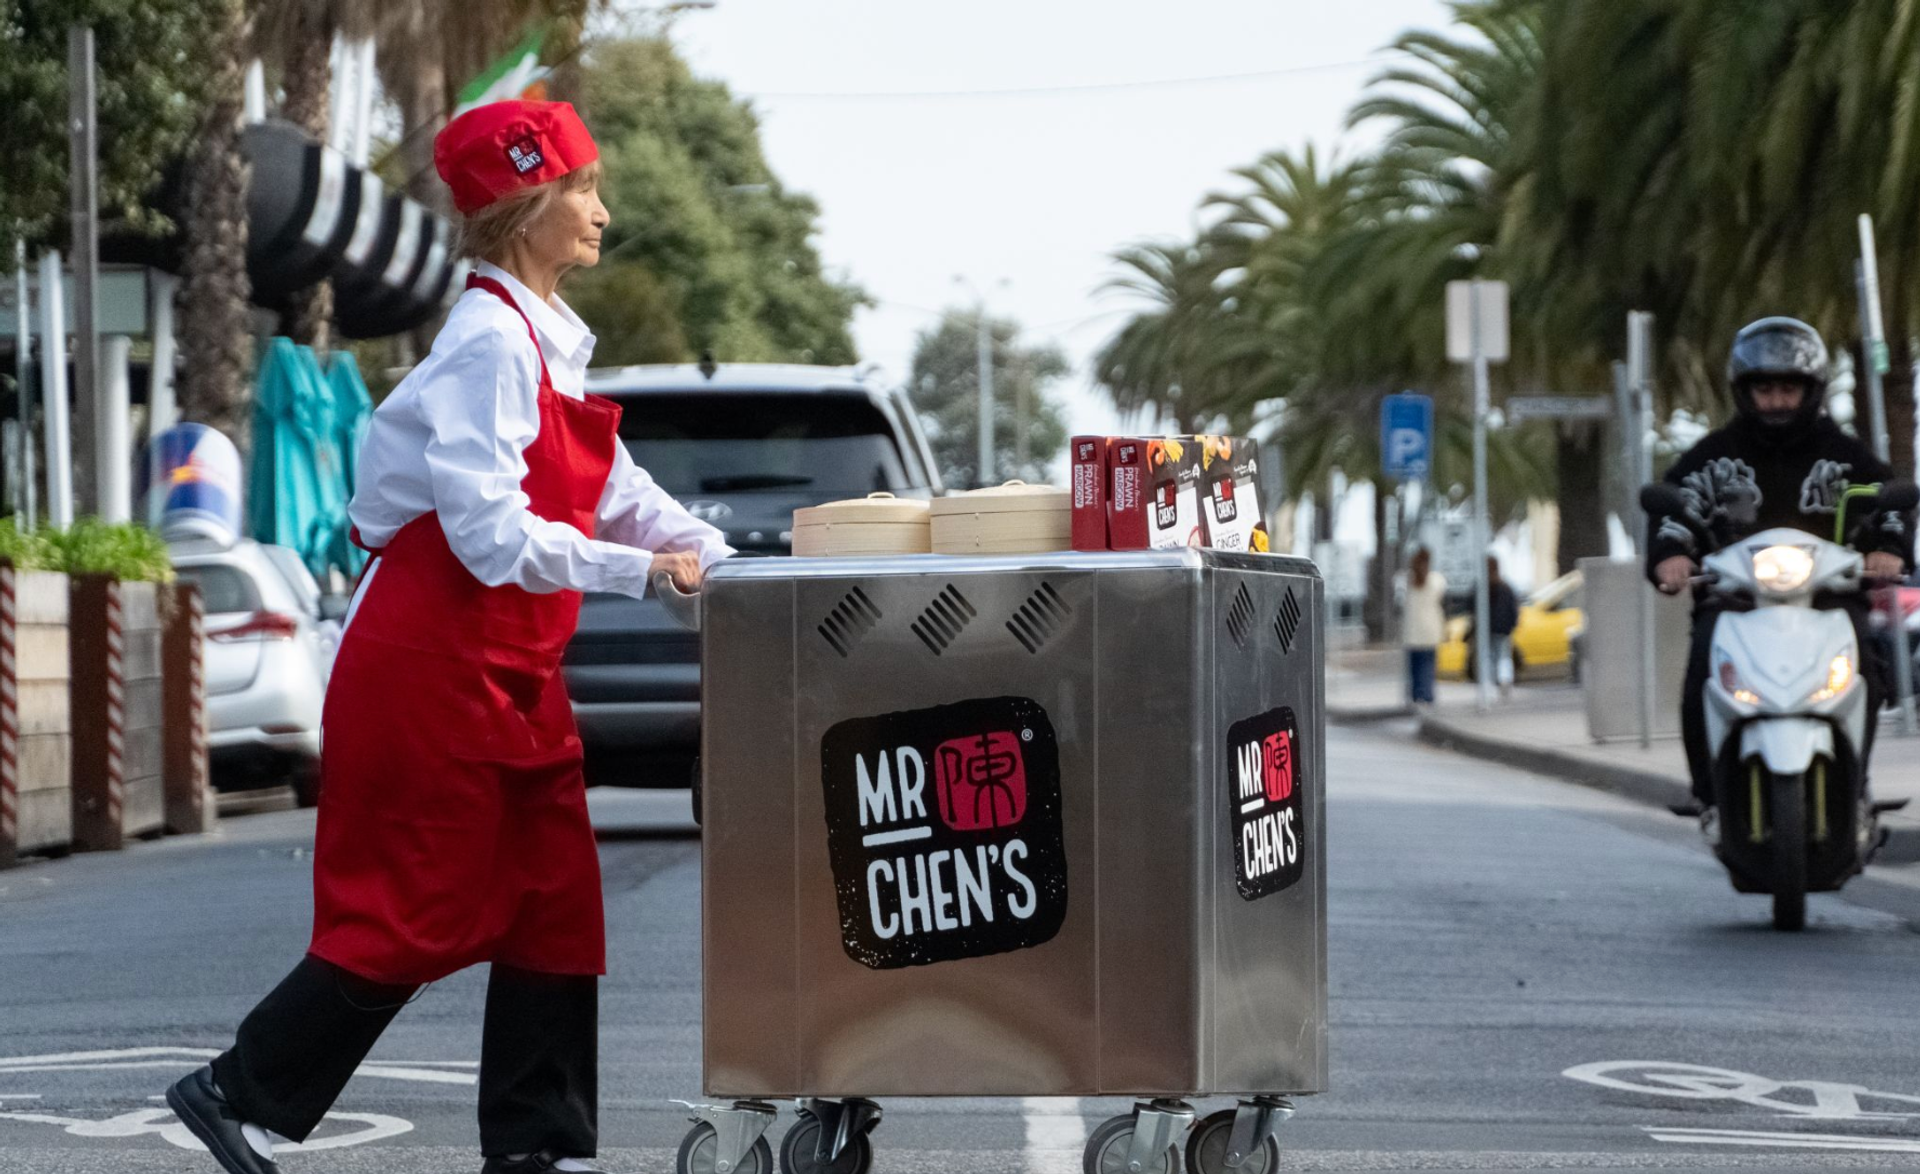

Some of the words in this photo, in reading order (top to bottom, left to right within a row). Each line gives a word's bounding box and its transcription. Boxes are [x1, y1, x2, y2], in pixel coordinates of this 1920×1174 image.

[508, 146, 522, 159] MR
[516, 151, 541, 173] CHEN'S
[1391, 428, 1424, 463] P
[1084, 464, 1093, 505] PRAWN
[1125, 467, 1134, 508] PRAWN
[1213, 481, 1222, 498] MR
[1158, 505, 1175, 526] CHEN'S
[1217, 499, 1235, 519] CHEN'S
[856, 745, 927, 827] MR
[1237, 741, 1263, 799] MR
[1242, 806, 1297, 880] CHEN'S
[866, 839, 1037, 940] CHEN'S
